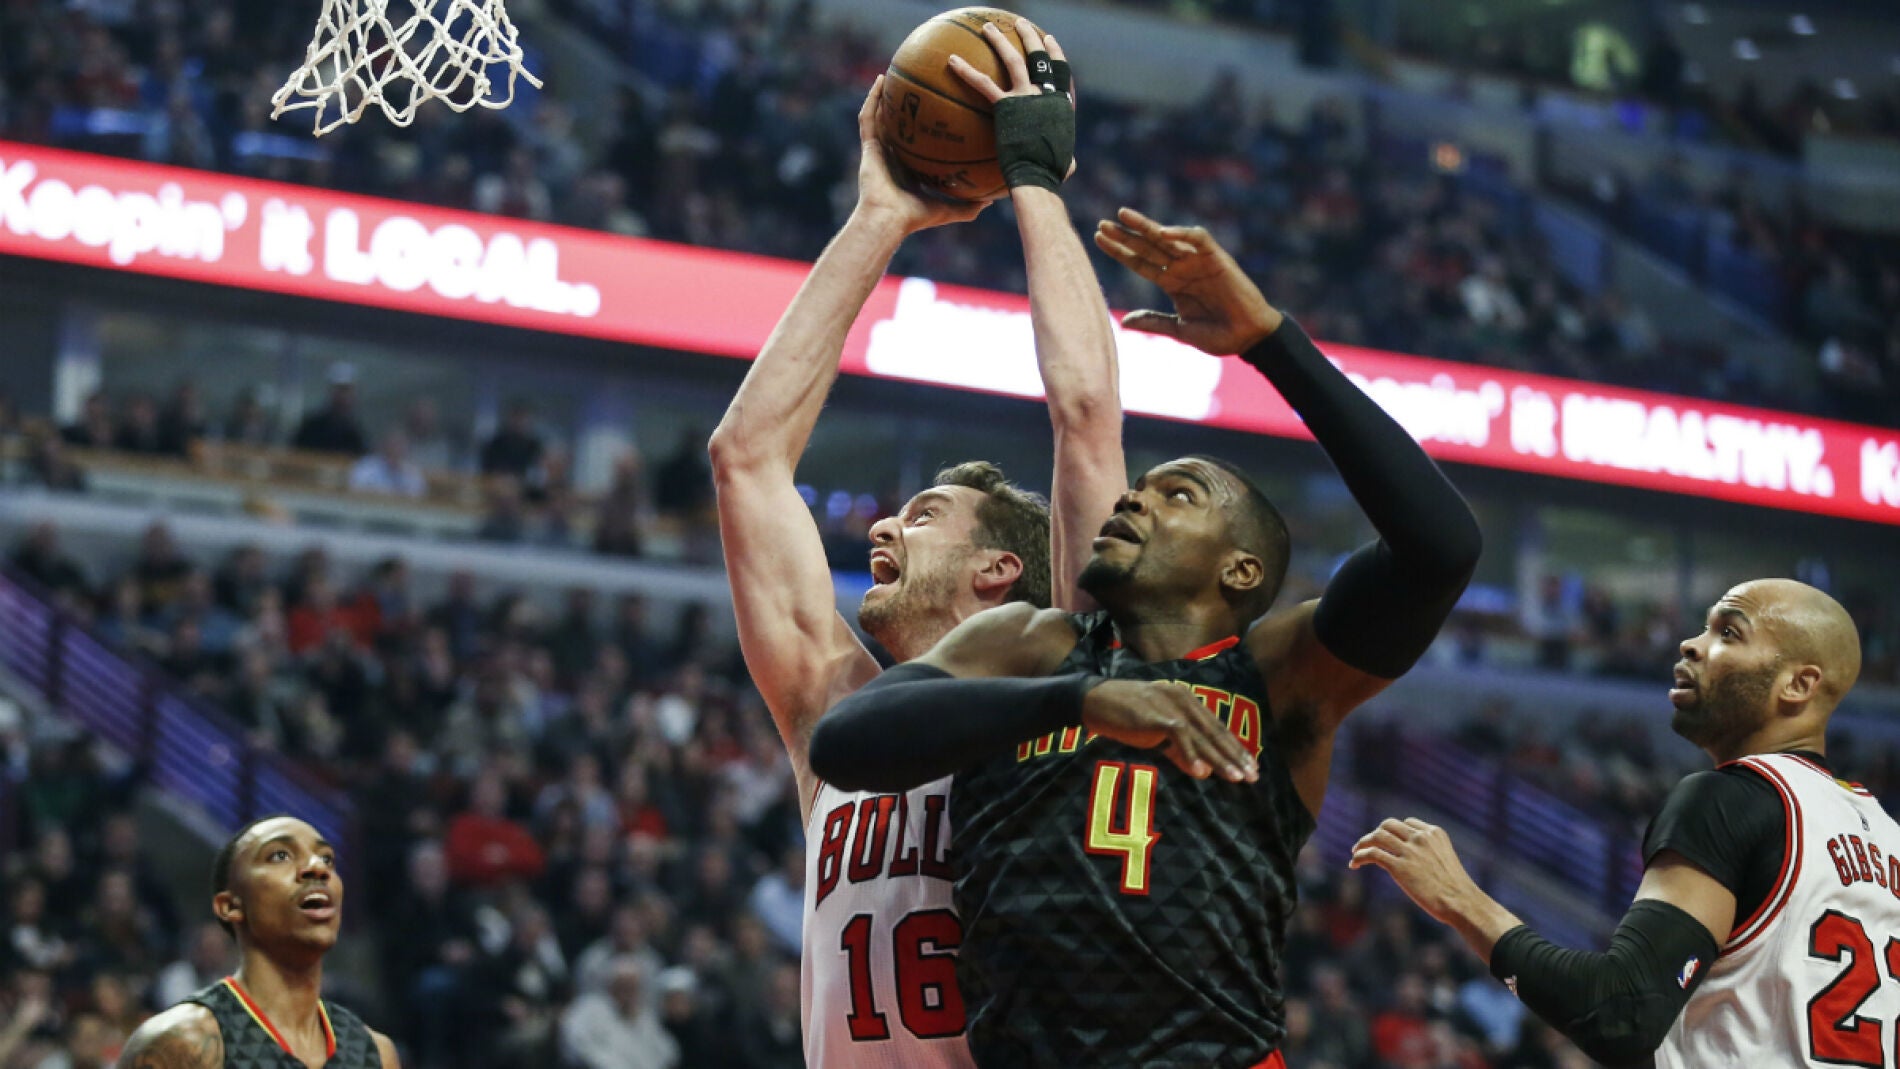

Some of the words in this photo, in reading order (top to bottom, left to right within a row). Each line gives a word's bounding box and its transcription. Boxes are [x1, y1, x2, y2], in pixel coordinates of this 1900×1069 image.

[0, 158, 247, 264] Keepin'
[260, 200, 313, 274] it
[1562, 393, 1834, 498] HEALTHY.
[816, 794, 954, 908] BULL
[1084, 760, 1162, 895] 4
[1826, 833, 1900, 901] GIBSO
[840, 909, 967, 1041] 16
[1807, 908, 1900, 1069] 2
